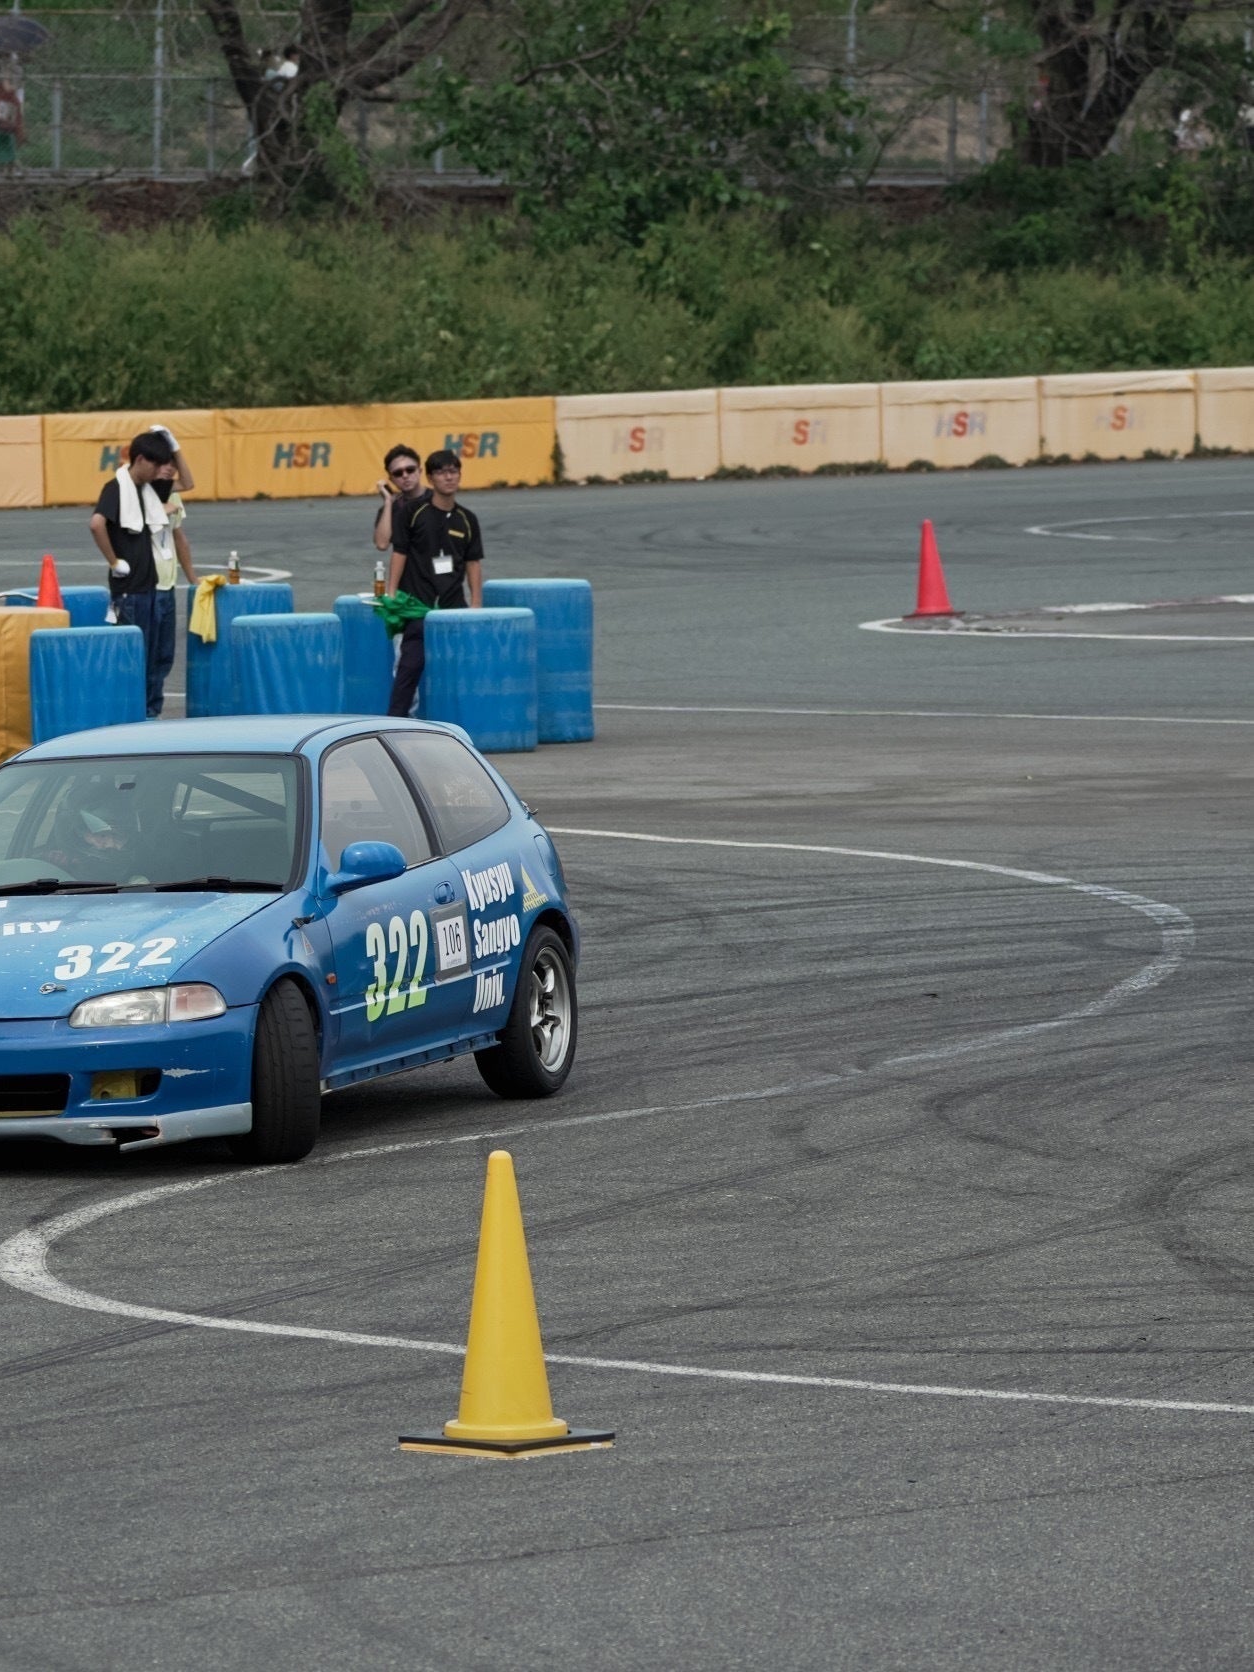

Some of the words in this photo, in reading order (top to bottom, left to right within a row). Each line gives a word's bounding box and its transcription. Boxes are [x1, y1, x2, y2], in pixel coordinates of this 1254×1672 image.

[273, 442, 331, 468] HSR
[444, 432, 501, 458] HSR
[461, 861, 515, 912] Kyusyu
[442, 922, 462, 956] 106
[473, 913, 520, 959] Sangyo
[54, 937, 178, 981] 322
[365, 909, 428, 1022] 322
[473, 967, 506, 1014] Univ.
